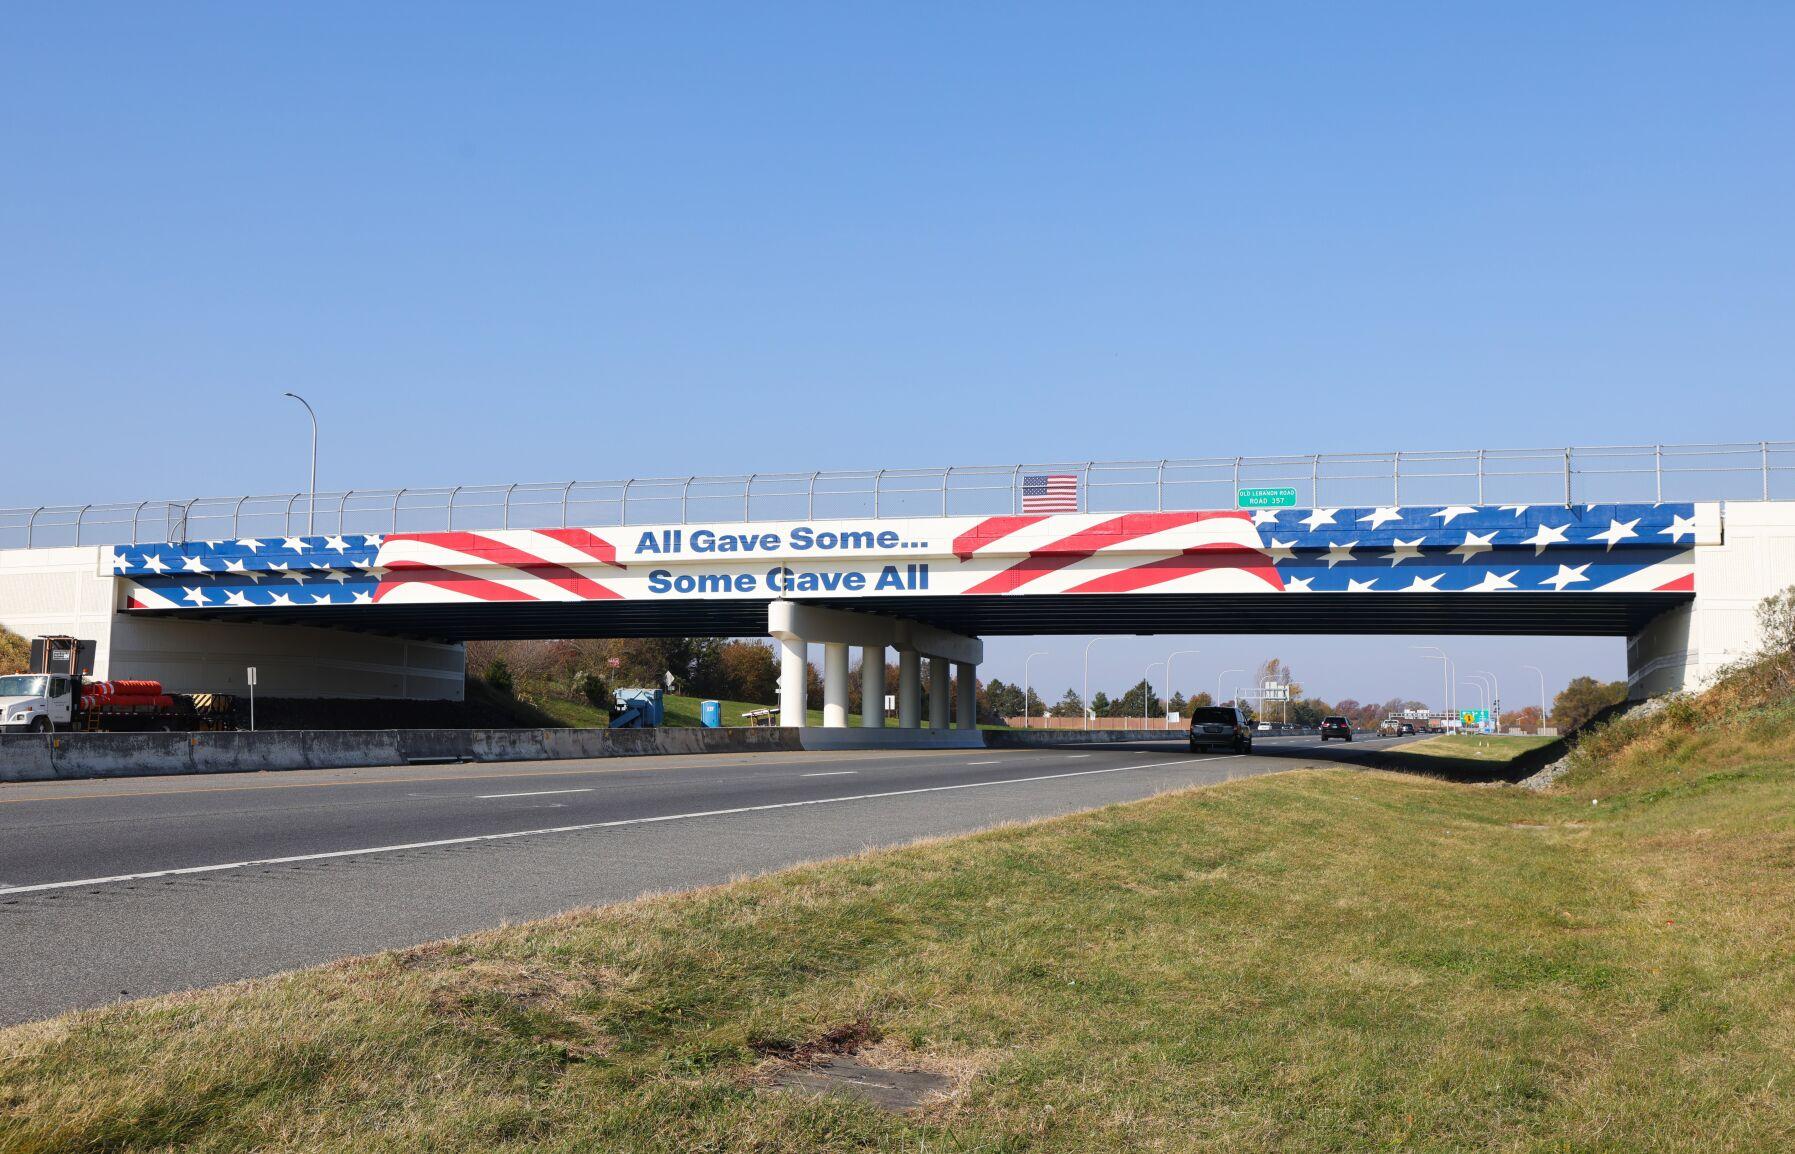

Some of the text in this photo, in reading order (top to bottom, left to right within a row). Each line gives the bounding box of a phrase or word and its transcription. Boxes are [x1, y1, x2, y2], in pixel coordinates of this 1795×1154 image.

[635, 527, 928, 554] All Gave Some...
[648, 564, 929, 594] Some Gave All
